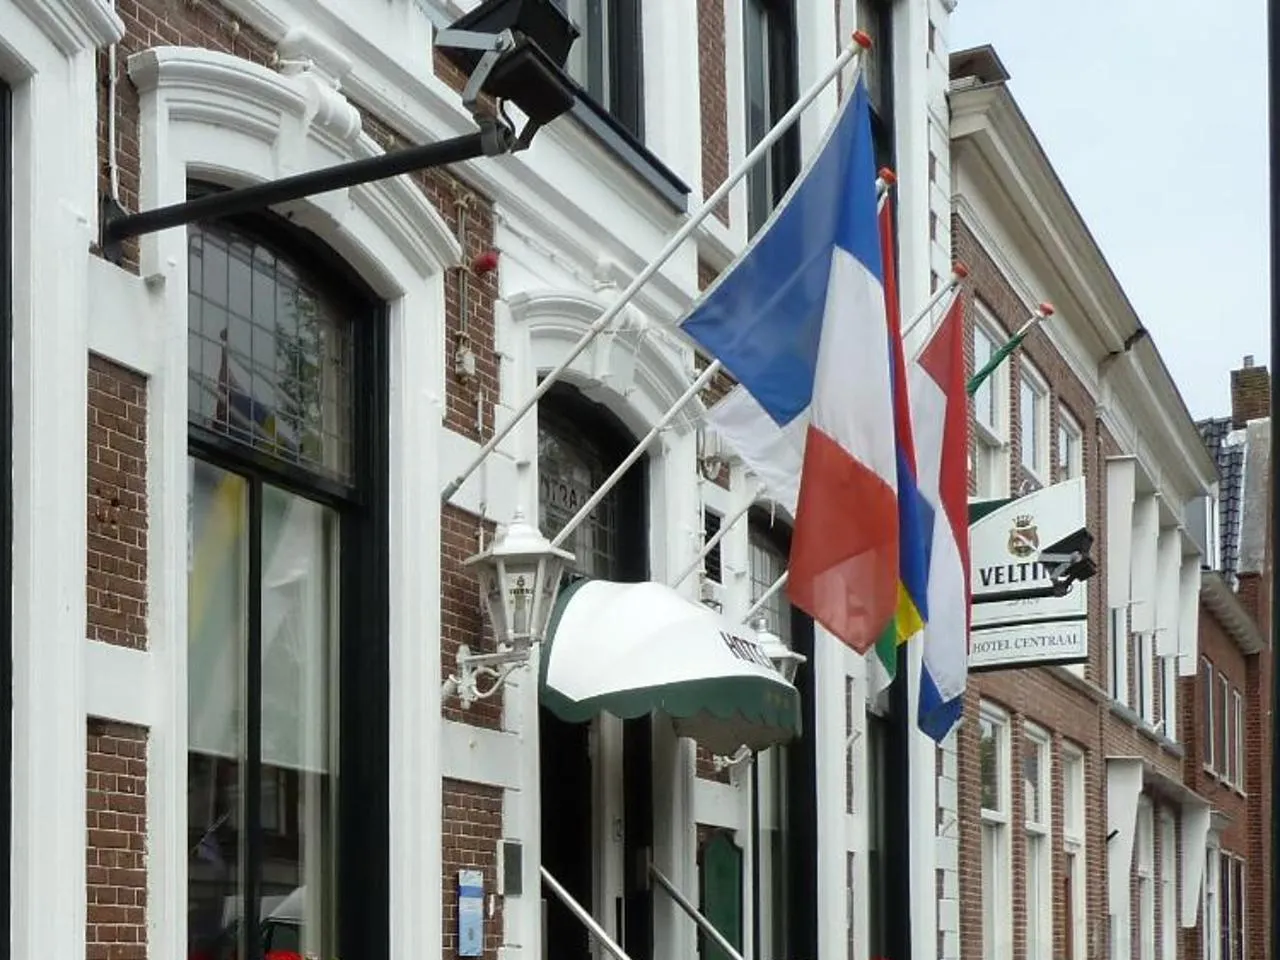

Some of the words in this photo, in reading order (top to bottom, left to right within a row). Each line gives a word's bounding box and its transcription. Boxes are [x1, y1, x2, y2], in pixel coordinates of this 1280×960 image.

[980, 561, 1048, 587] VELTI
[974, 639, 1012, 653] HOTEL
[1014, 633, 1077, 650] CENTRAAL
